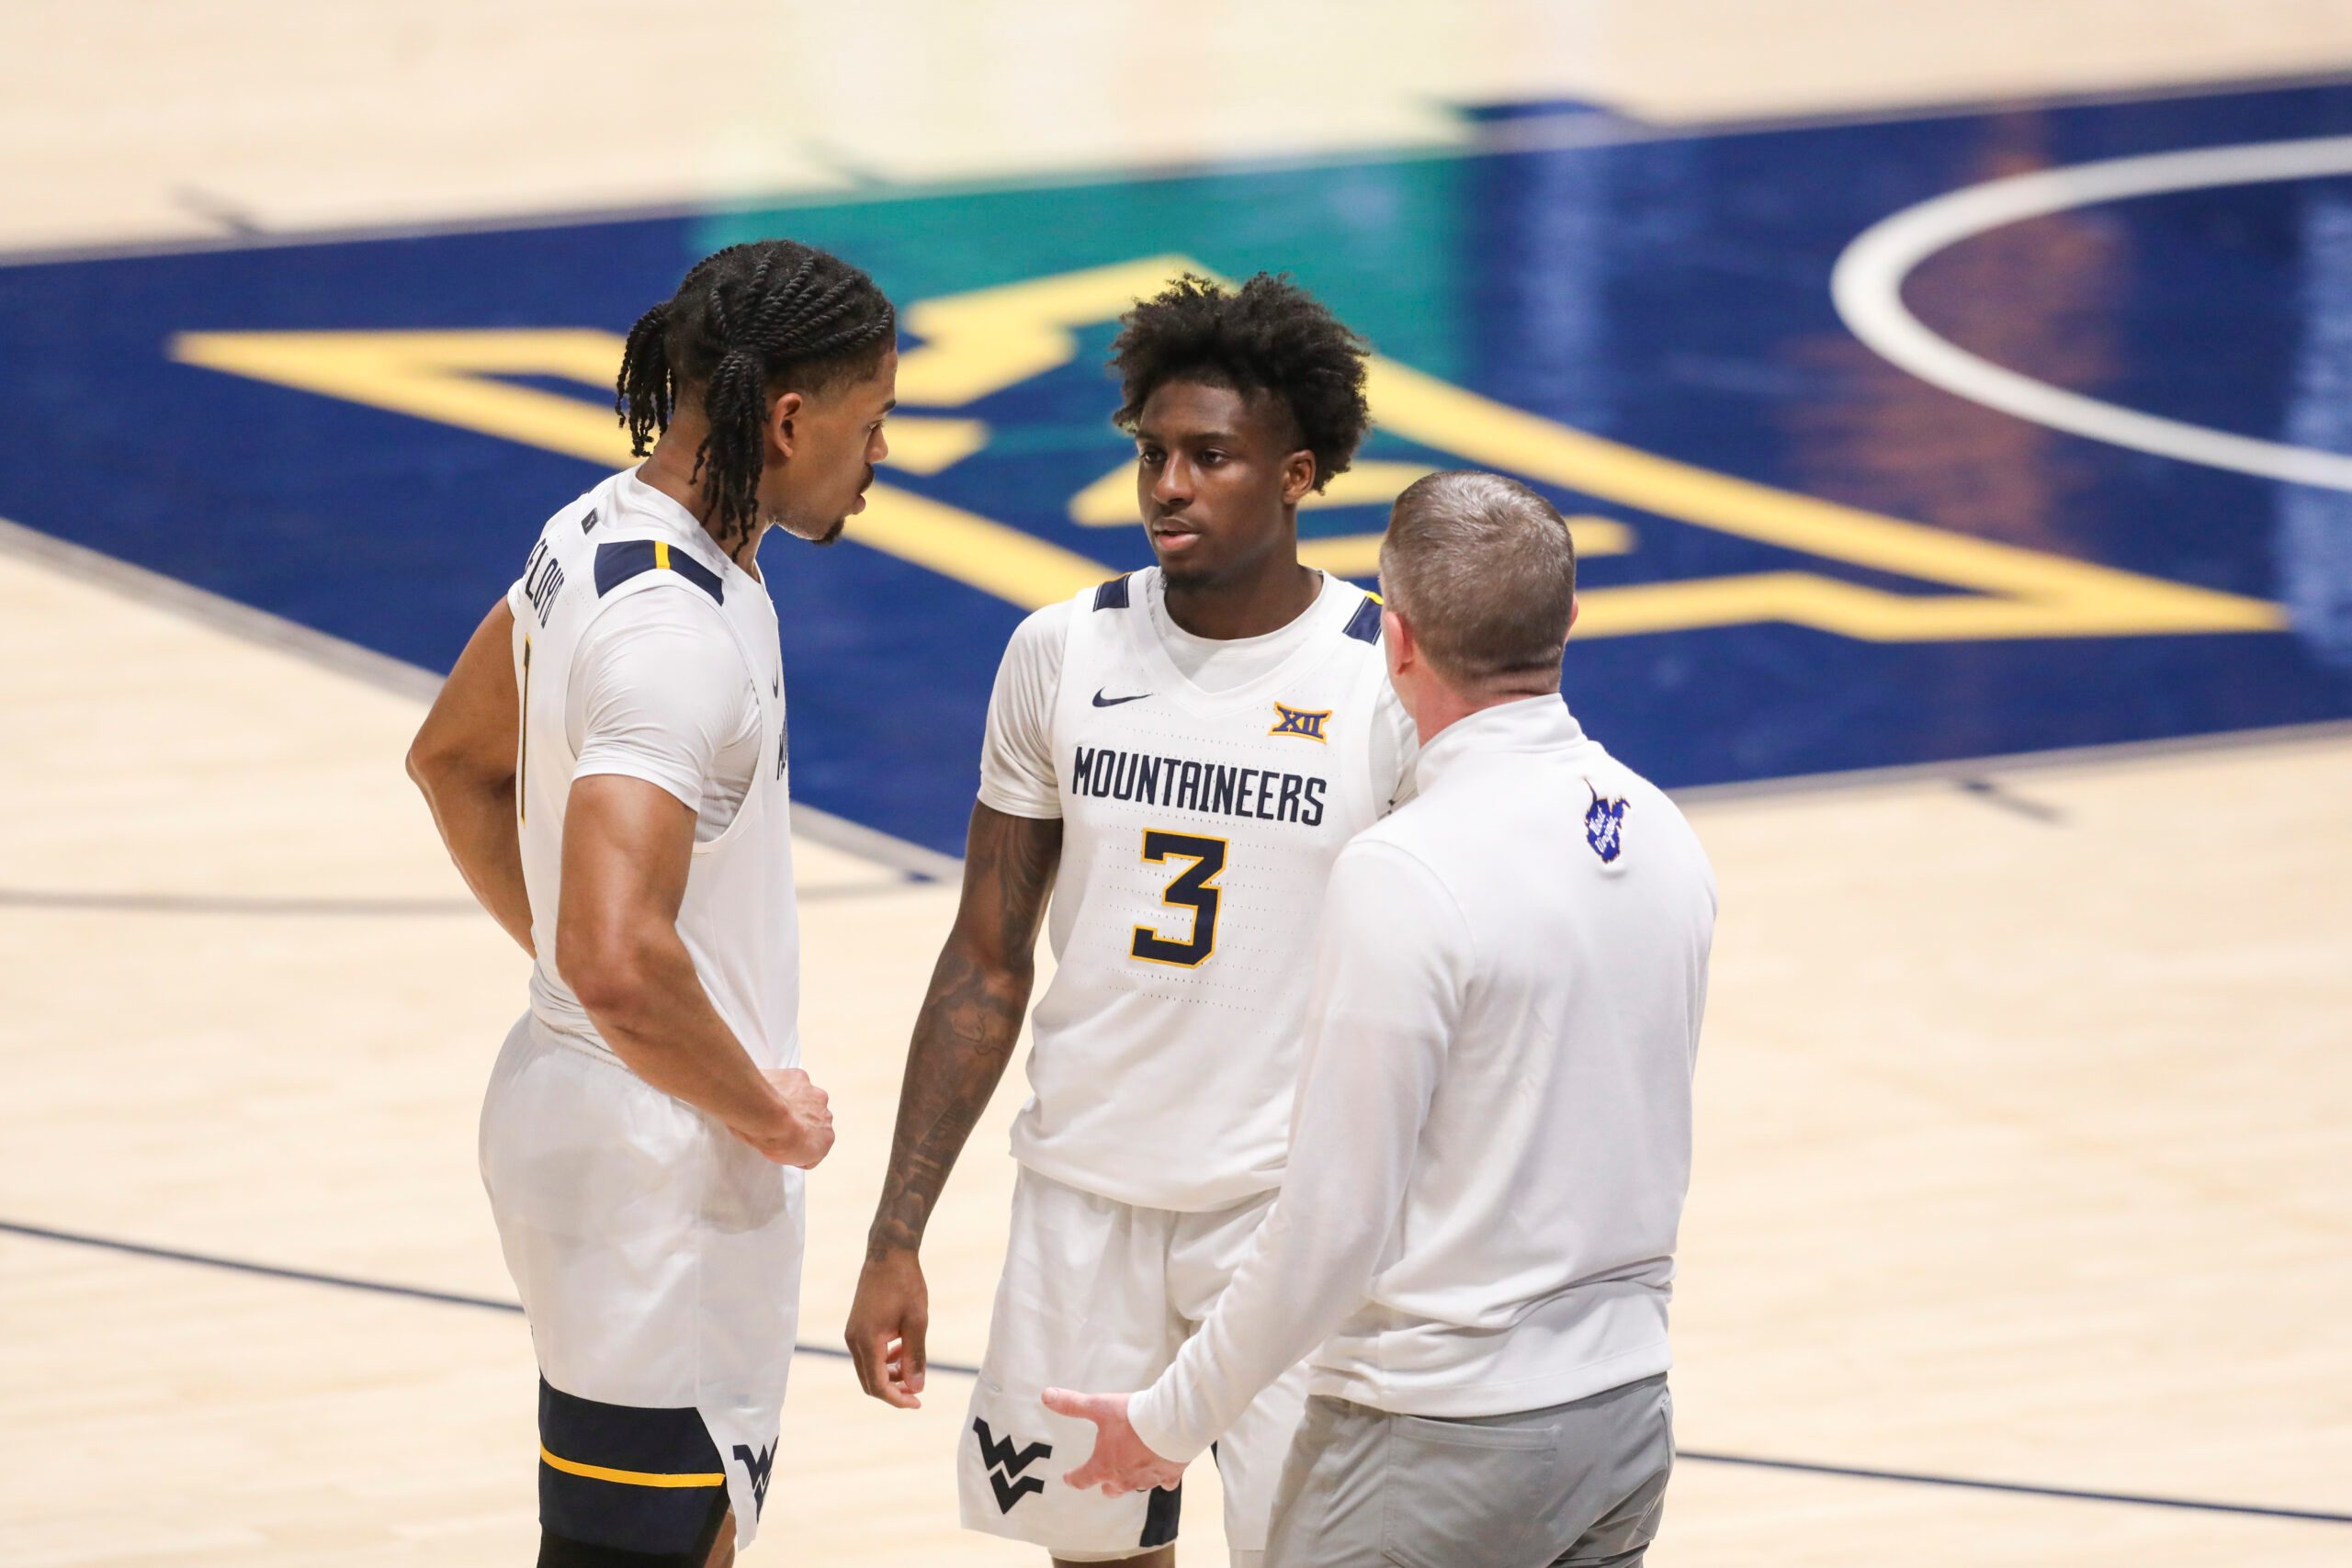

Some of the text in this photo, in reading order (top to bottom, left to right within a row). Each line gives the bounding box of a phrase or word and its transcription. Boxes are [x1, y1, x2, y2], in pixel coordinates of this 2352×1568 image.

[1270, 703, 1330, 742] XII
[1072, 746, 1327, 827] MOUNTAINEERS
[1129, 828, 1229, 969] 3
